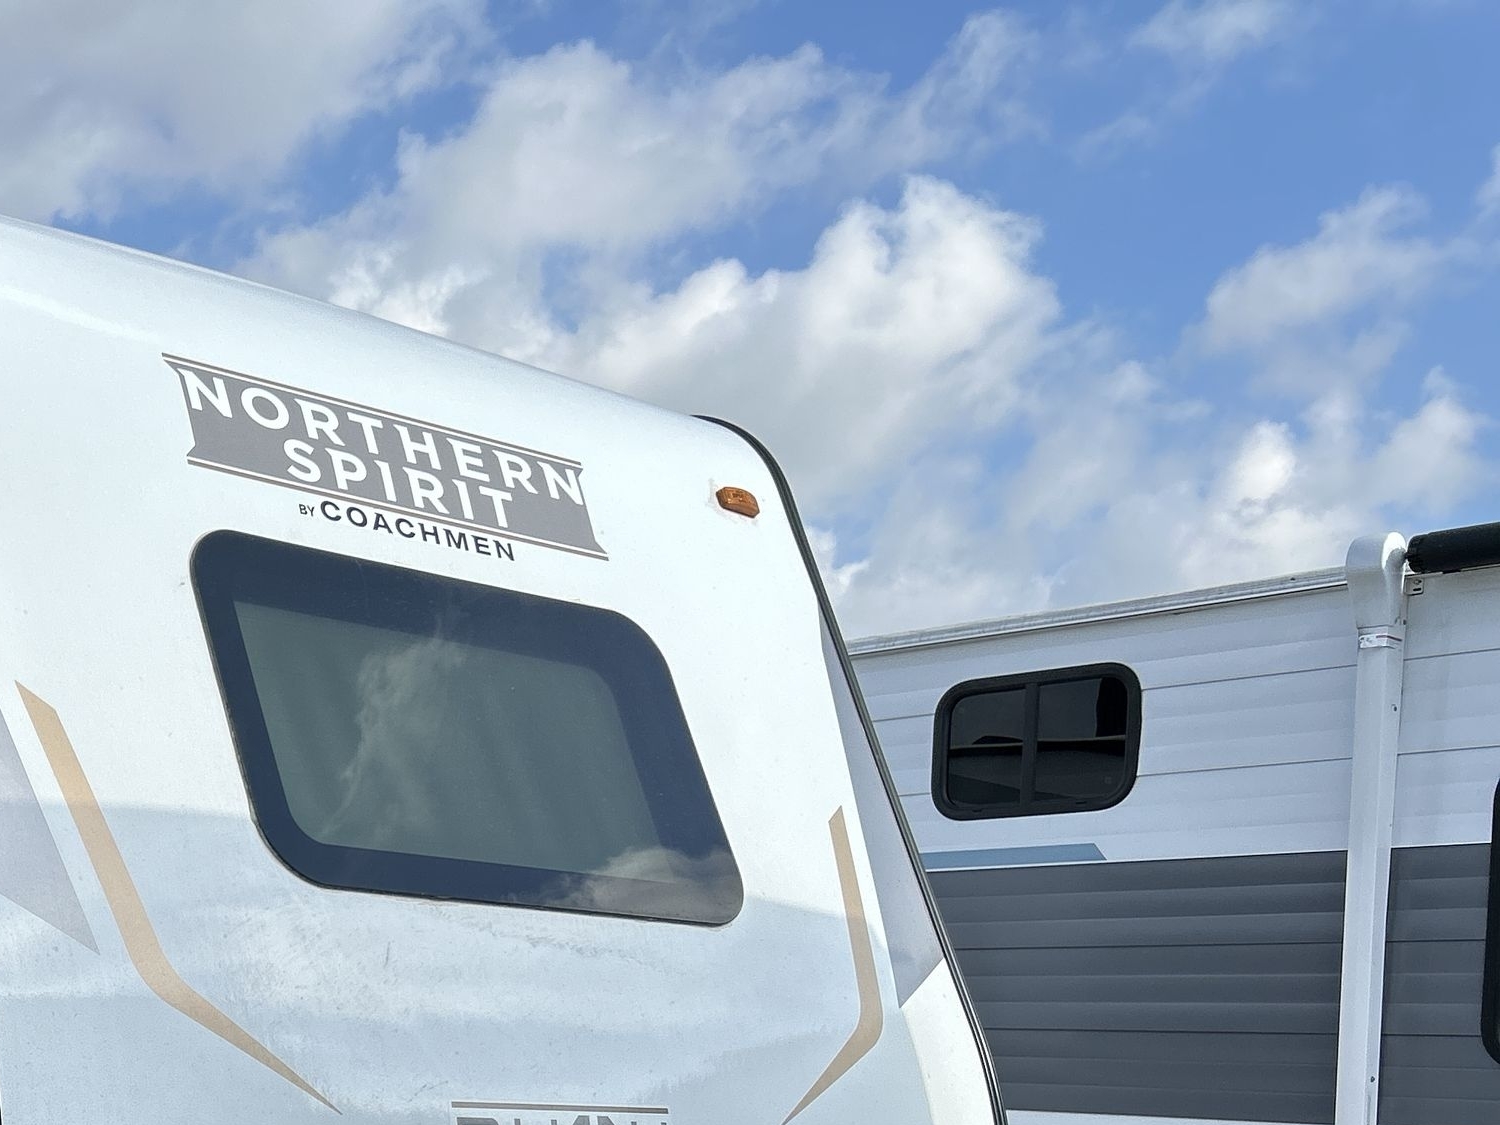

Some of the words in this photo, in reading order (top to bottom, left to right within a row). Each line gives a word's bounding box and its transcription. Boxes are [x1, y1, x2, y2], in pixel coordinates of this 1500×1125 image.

[179, 368, 584, 506] NORTHERN
[284, 440, 513, 529] SPIRIT
[298, 503, 316, 517] BY
[320, 500, 516, 562] COACHMEN
